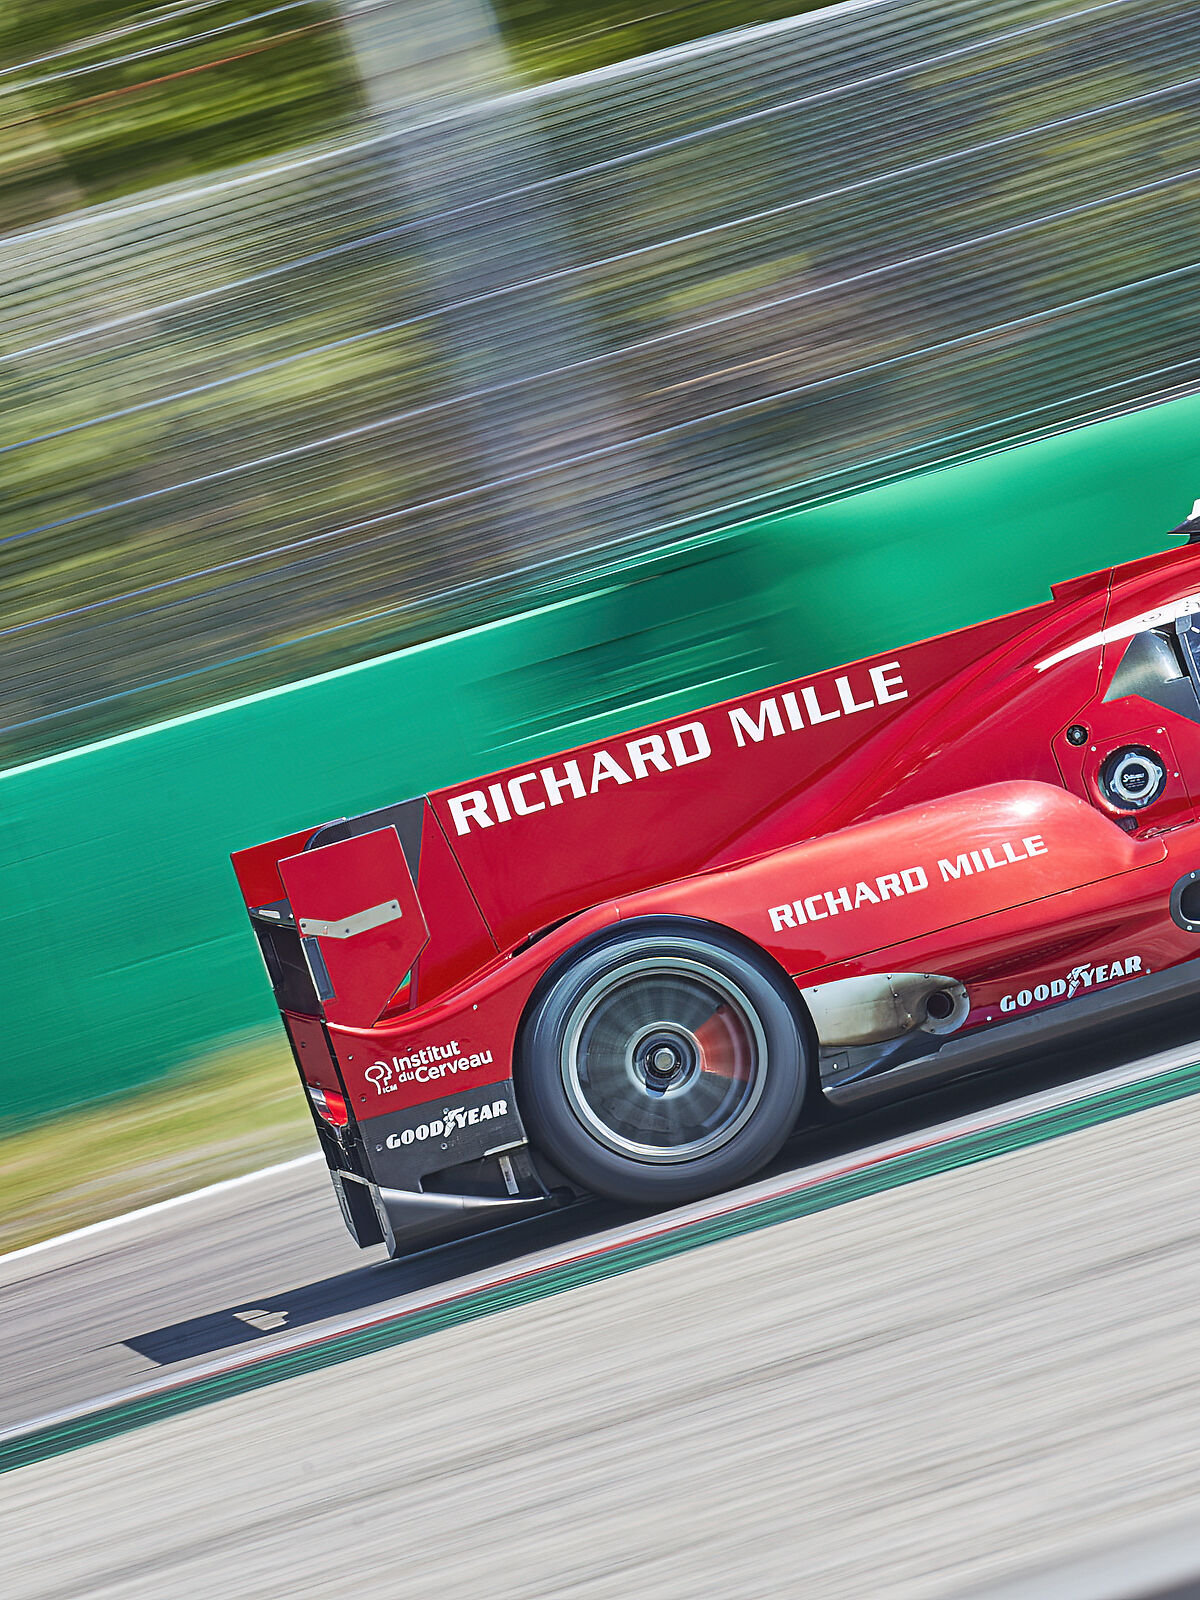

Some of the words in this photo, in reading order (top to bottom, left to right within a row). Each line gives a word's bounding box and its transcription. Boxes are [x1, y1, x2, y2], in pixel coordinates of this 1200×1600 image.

[447, 721, 712, 836] RICHARD
[728, 661, 909, 748] MILLE
[767, 866, 929, 932] RICHARD
[937, 834, 1049, 882] MILLE
[999, 954, 1142, 1013] GOODYEAR
[392, 1040, 461, 1073] Institut
[398, 1070, 415, 1083] du
[414, 1049, 493, 1083] Cerveau
[382, 1083, 398, 1094] ICM
[385, 1099, 508, 1150] GOODYEAR
